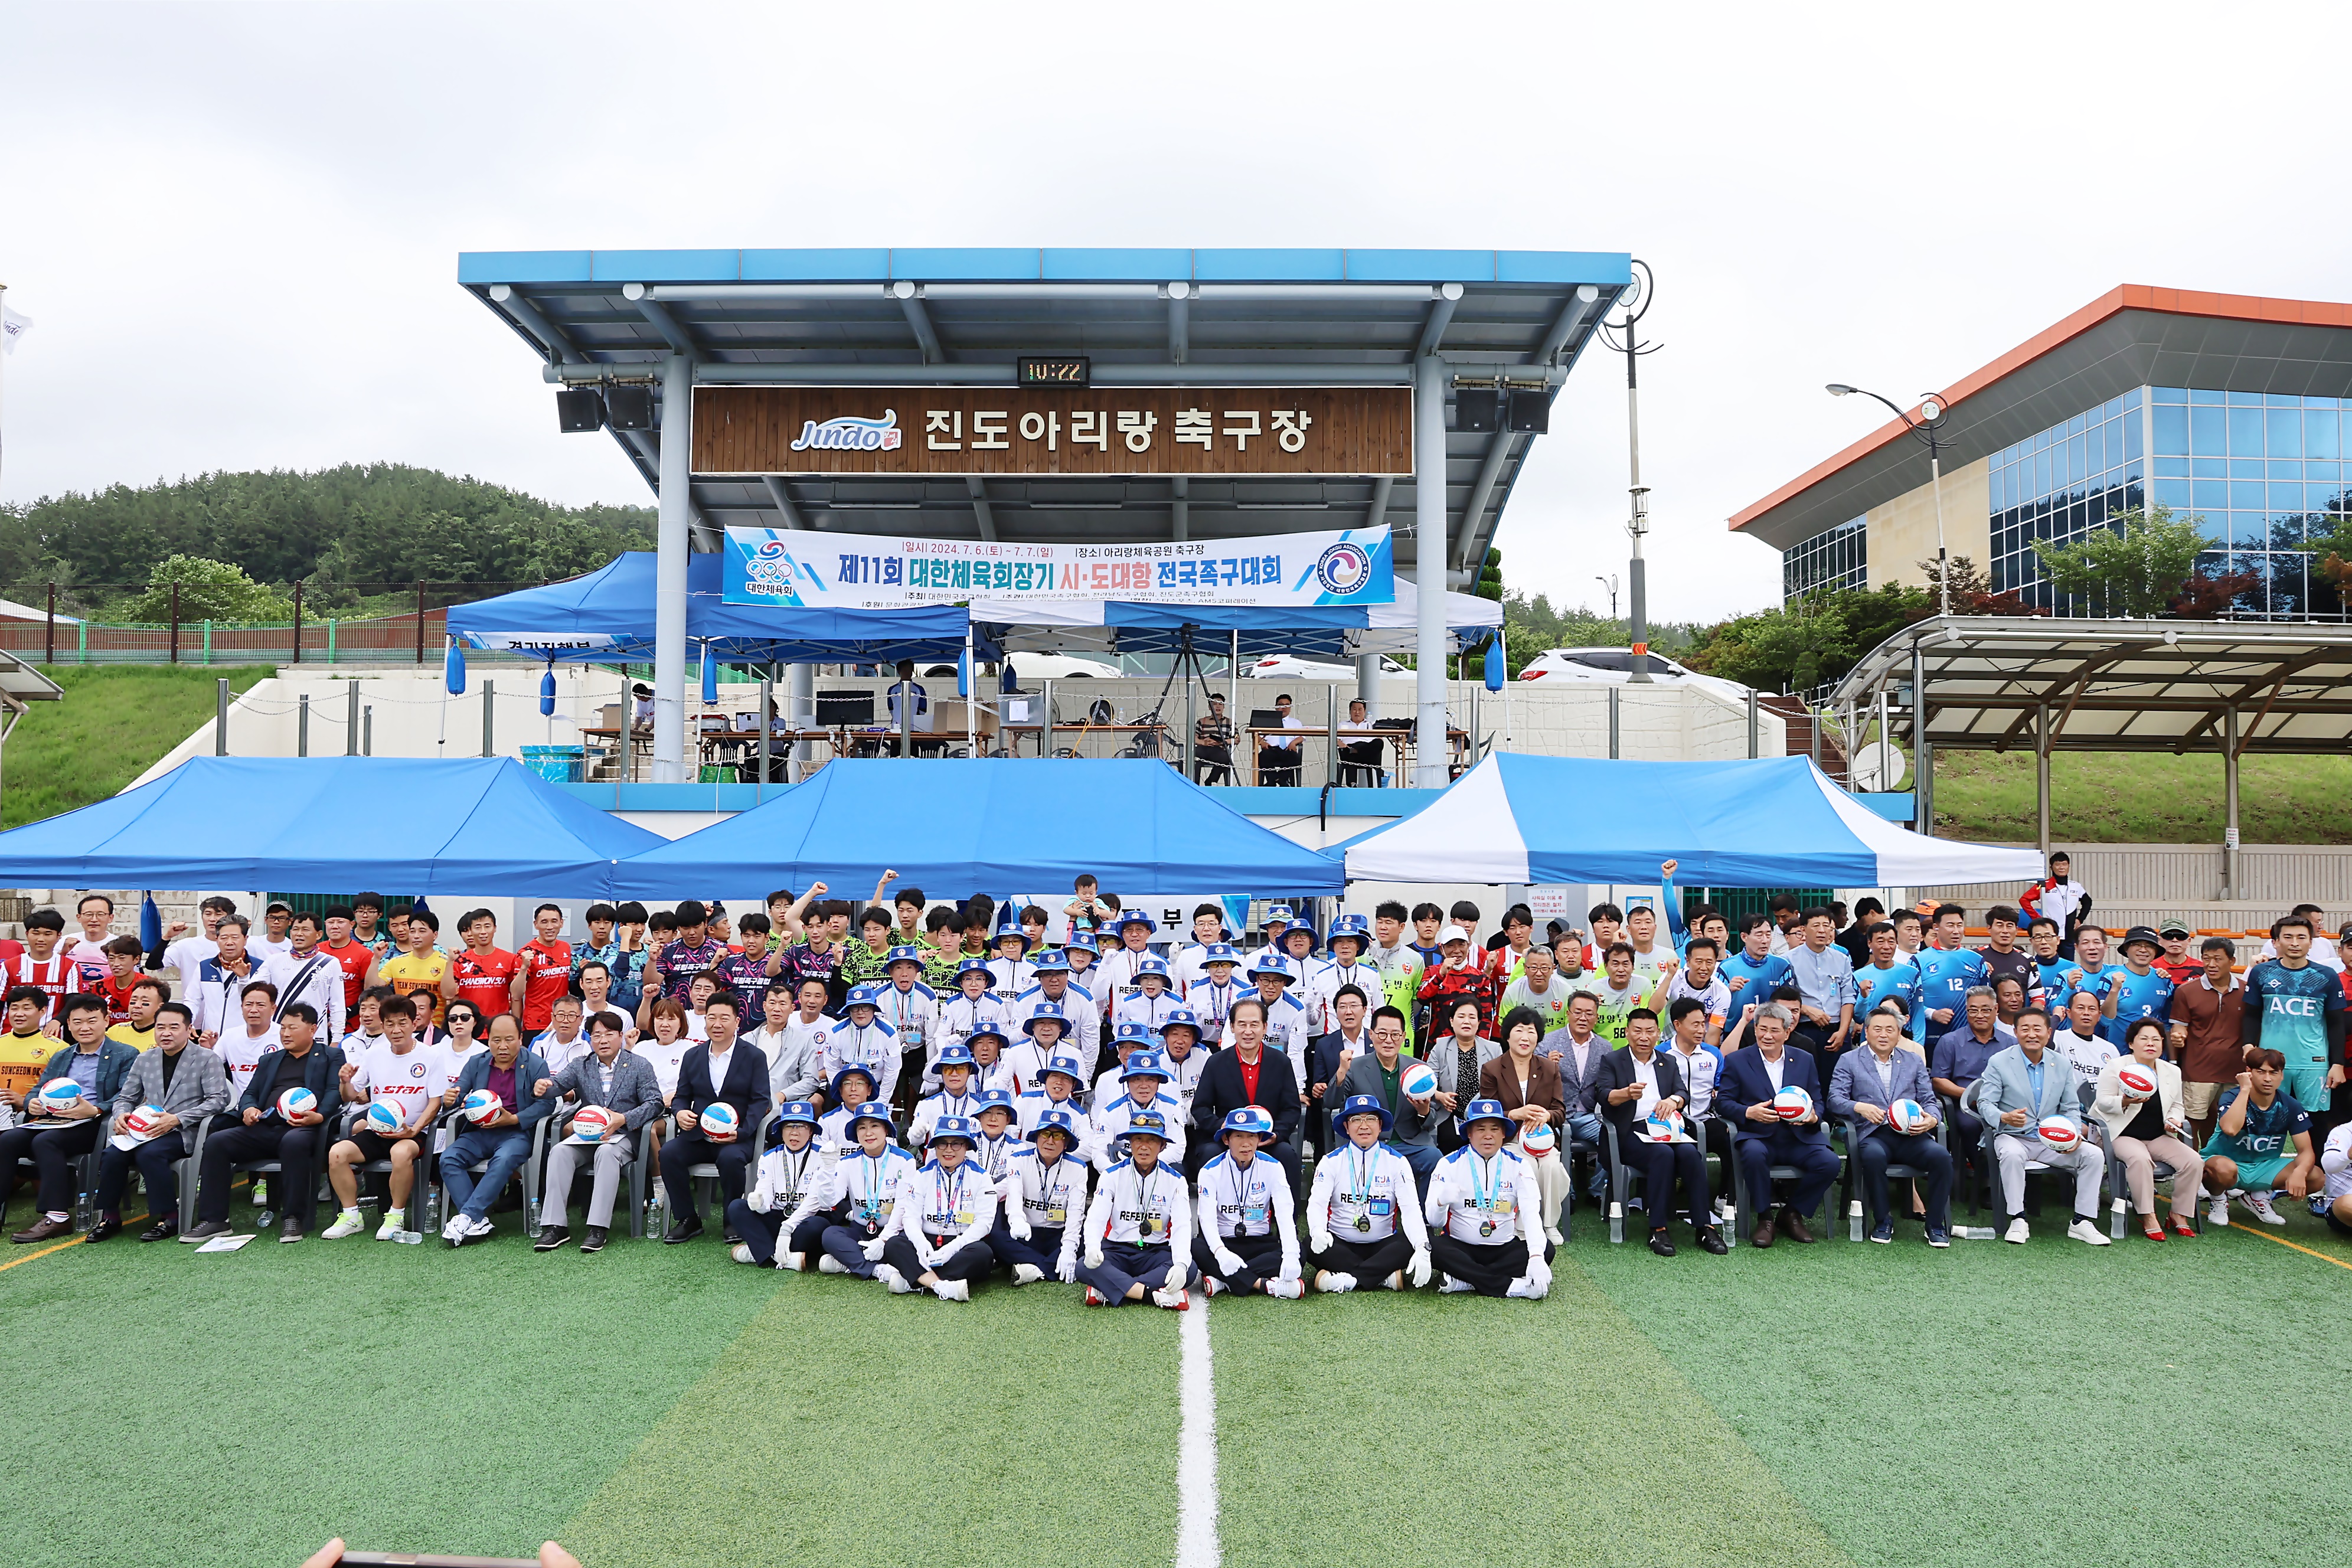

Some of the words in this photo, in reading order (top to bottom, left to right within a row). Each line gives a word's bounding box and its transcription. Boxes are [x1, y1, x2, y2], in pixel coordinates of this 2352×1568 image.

[793, 423, 881, 448] Jindo
[926, 410, 1158, 453] 진도아리랑
[1174, 408, 1312, 453] 축구장
[1104, 546, 1172, 558] 아리랑체육공원
[1175, 544, 1204, 556] 축구장
[1319, 554, 1328, 569] KOREA
[1327, 544, 1342, 555] JOKGU
[1342, 544, 1367, 564] ASSOCIATION
[838, 554, 903, 586] 제11회
[909, 558, 1054, 590] 대한체육회장기
[1158, 555, 1281, 588] 전국족구대회
[747, 582, 792, 596] 대한체육회
[538, 953, 546, 965] 11
[459, 977, 494, 985] CHANGWON
[1946, 978, 1964, 991] 12
[747, 990, 754, 1003] 7
[2142, 1005, 2152, 1017] 3
[2269, 997, 2317, 1017] ACE
[1, 1066, 31, 1075] SUNCHEON
[2236, 1135, 2282, 1152] ACE
